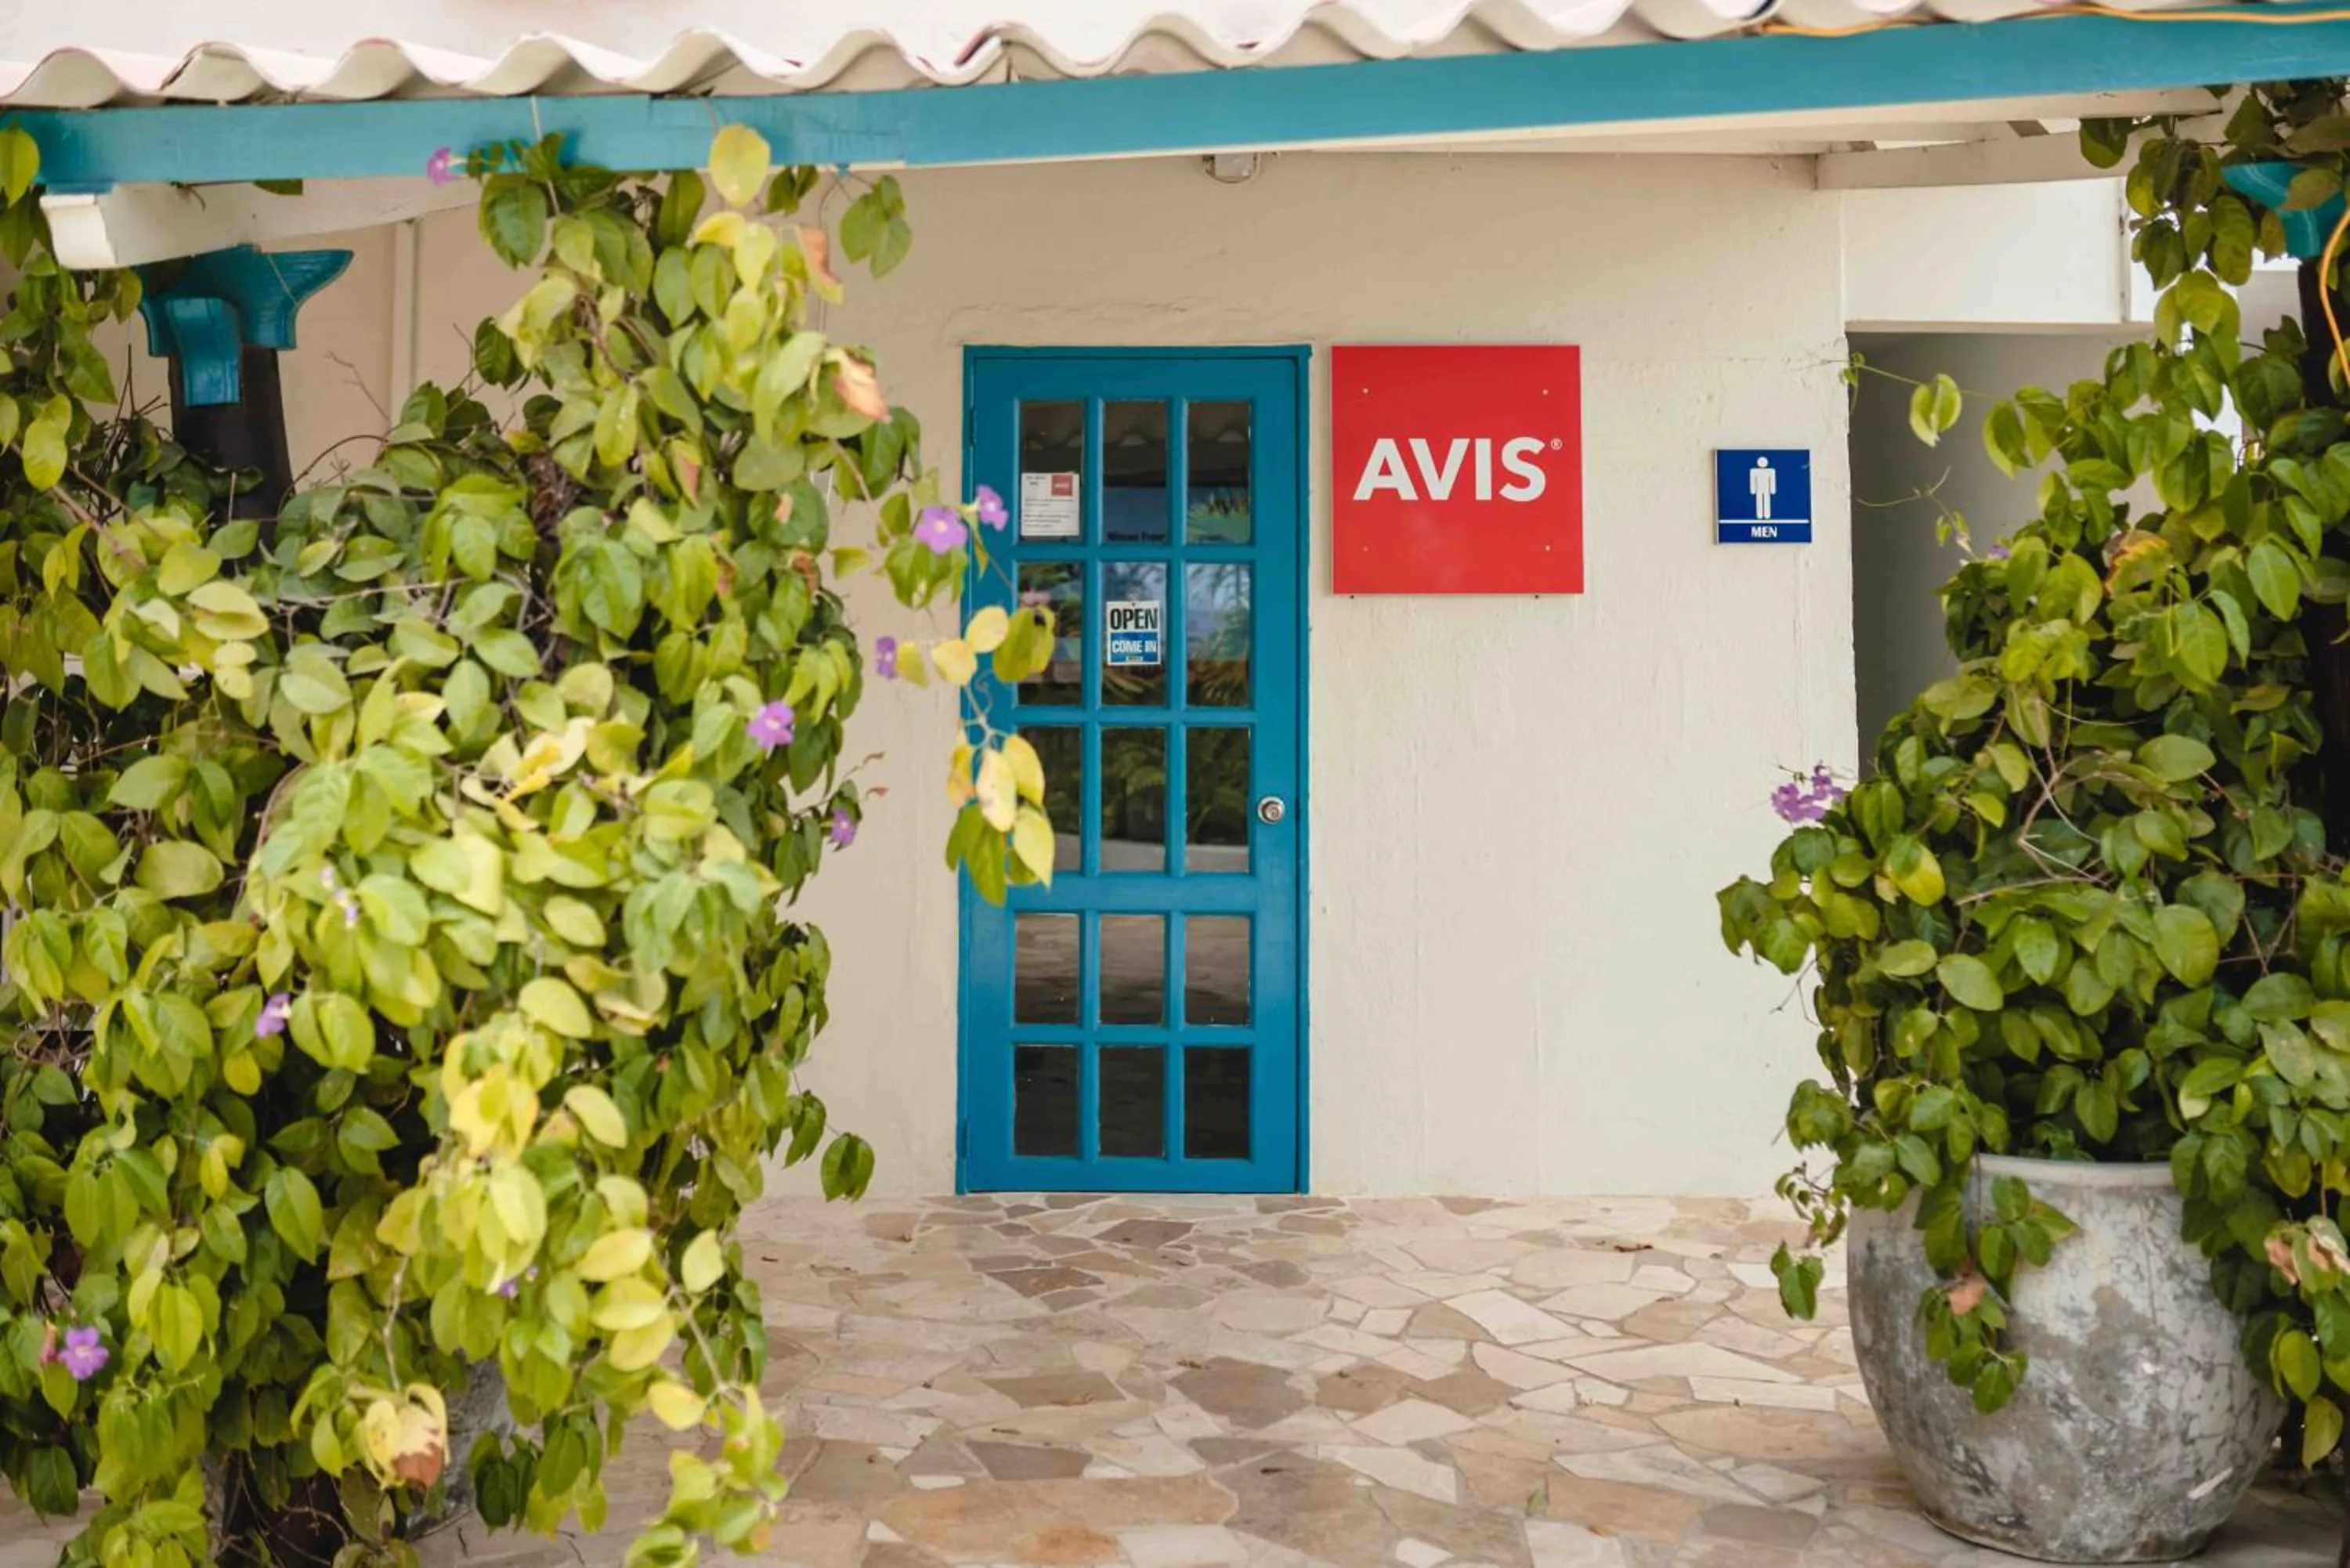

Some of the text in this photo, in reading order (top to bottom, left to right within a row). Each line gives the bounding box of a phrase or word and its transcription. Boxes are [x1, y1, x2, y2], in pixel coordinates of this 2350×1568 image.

[1352, 436, 1546, 502] AVIS
[1751, 526, 1777, 538] MEN
[1110, 608, 1158, 630] OPEN
[1112, 640, 1157, 653] COME IN
